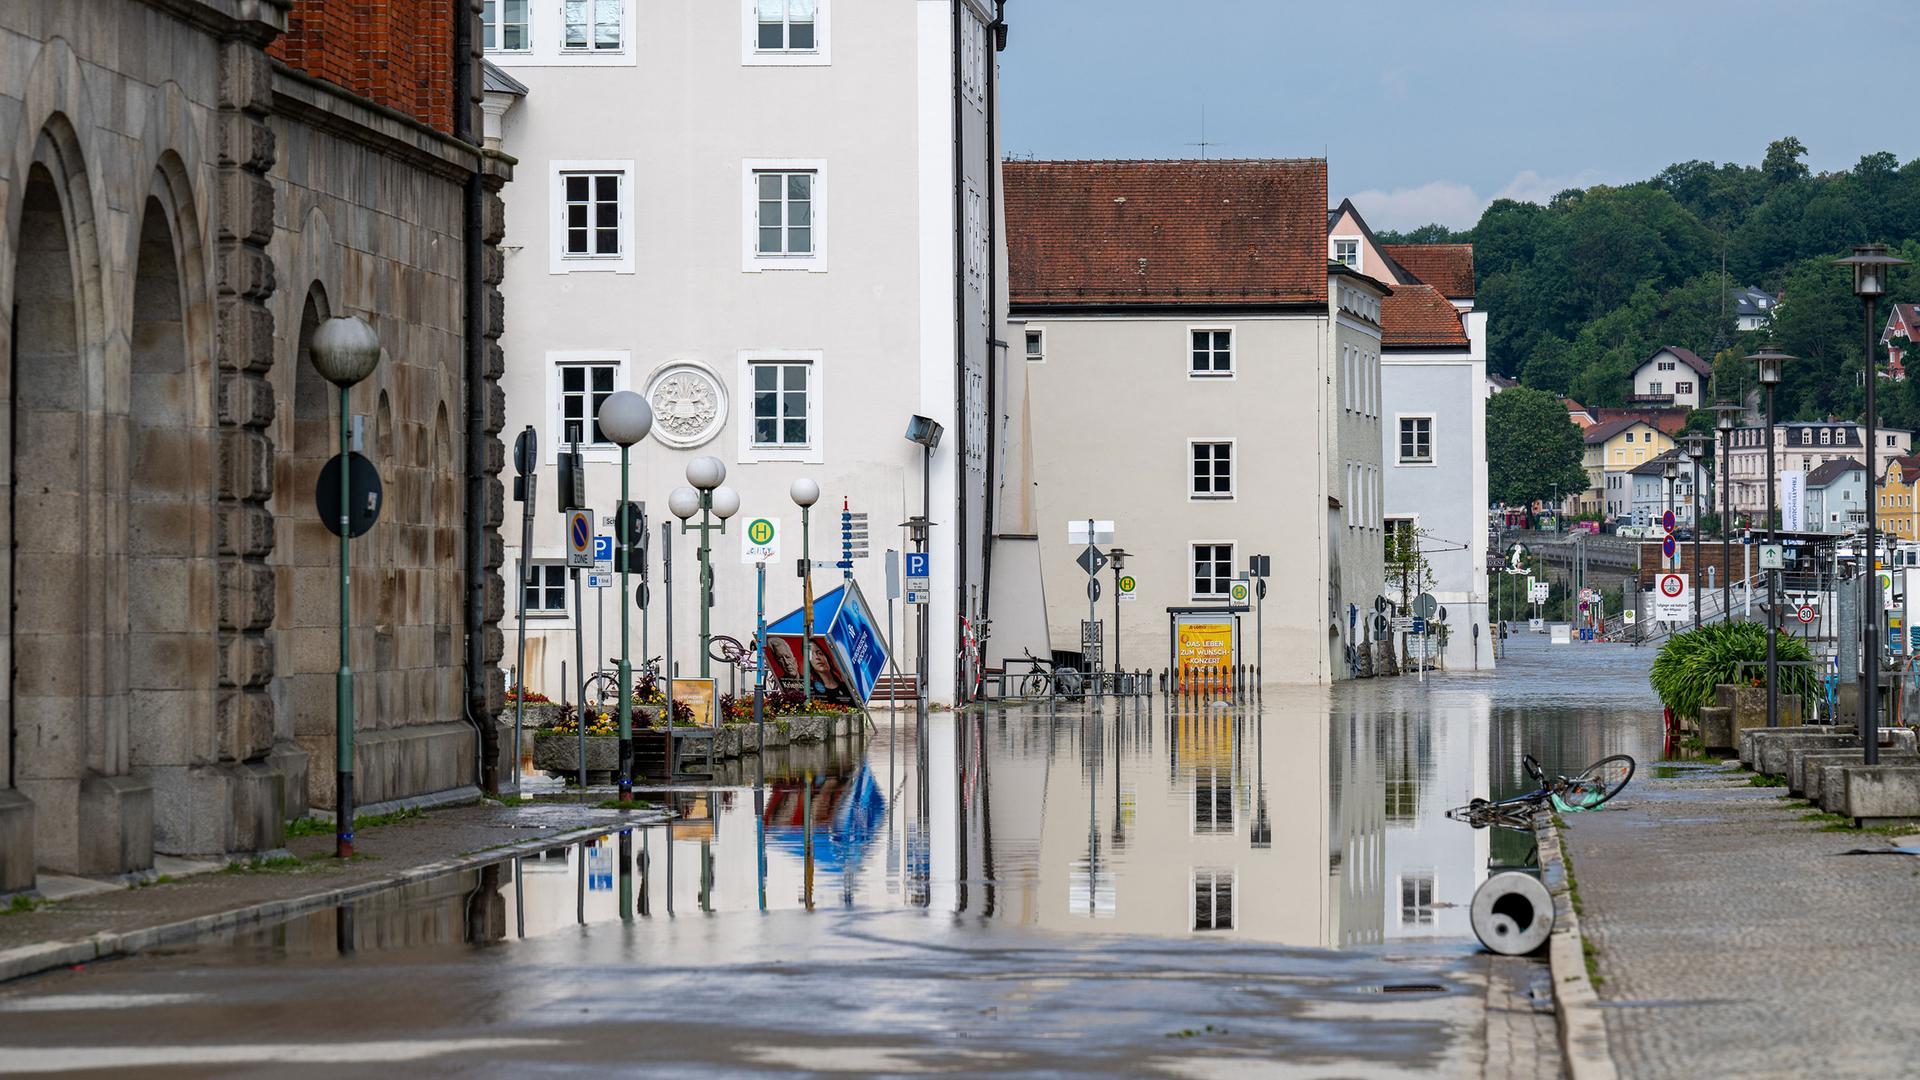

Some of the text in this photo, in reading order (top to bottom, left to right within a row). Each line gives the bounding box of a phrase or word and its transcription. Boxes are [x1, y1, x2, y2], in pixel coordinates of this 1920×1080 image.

[755, 525, 767, 539] H
[594, 540, 606, 557] P
[574, 554, 588, 564] ZONE
[911, 556, 924, 574] P
[1801, 609, 1811, 618] 30
